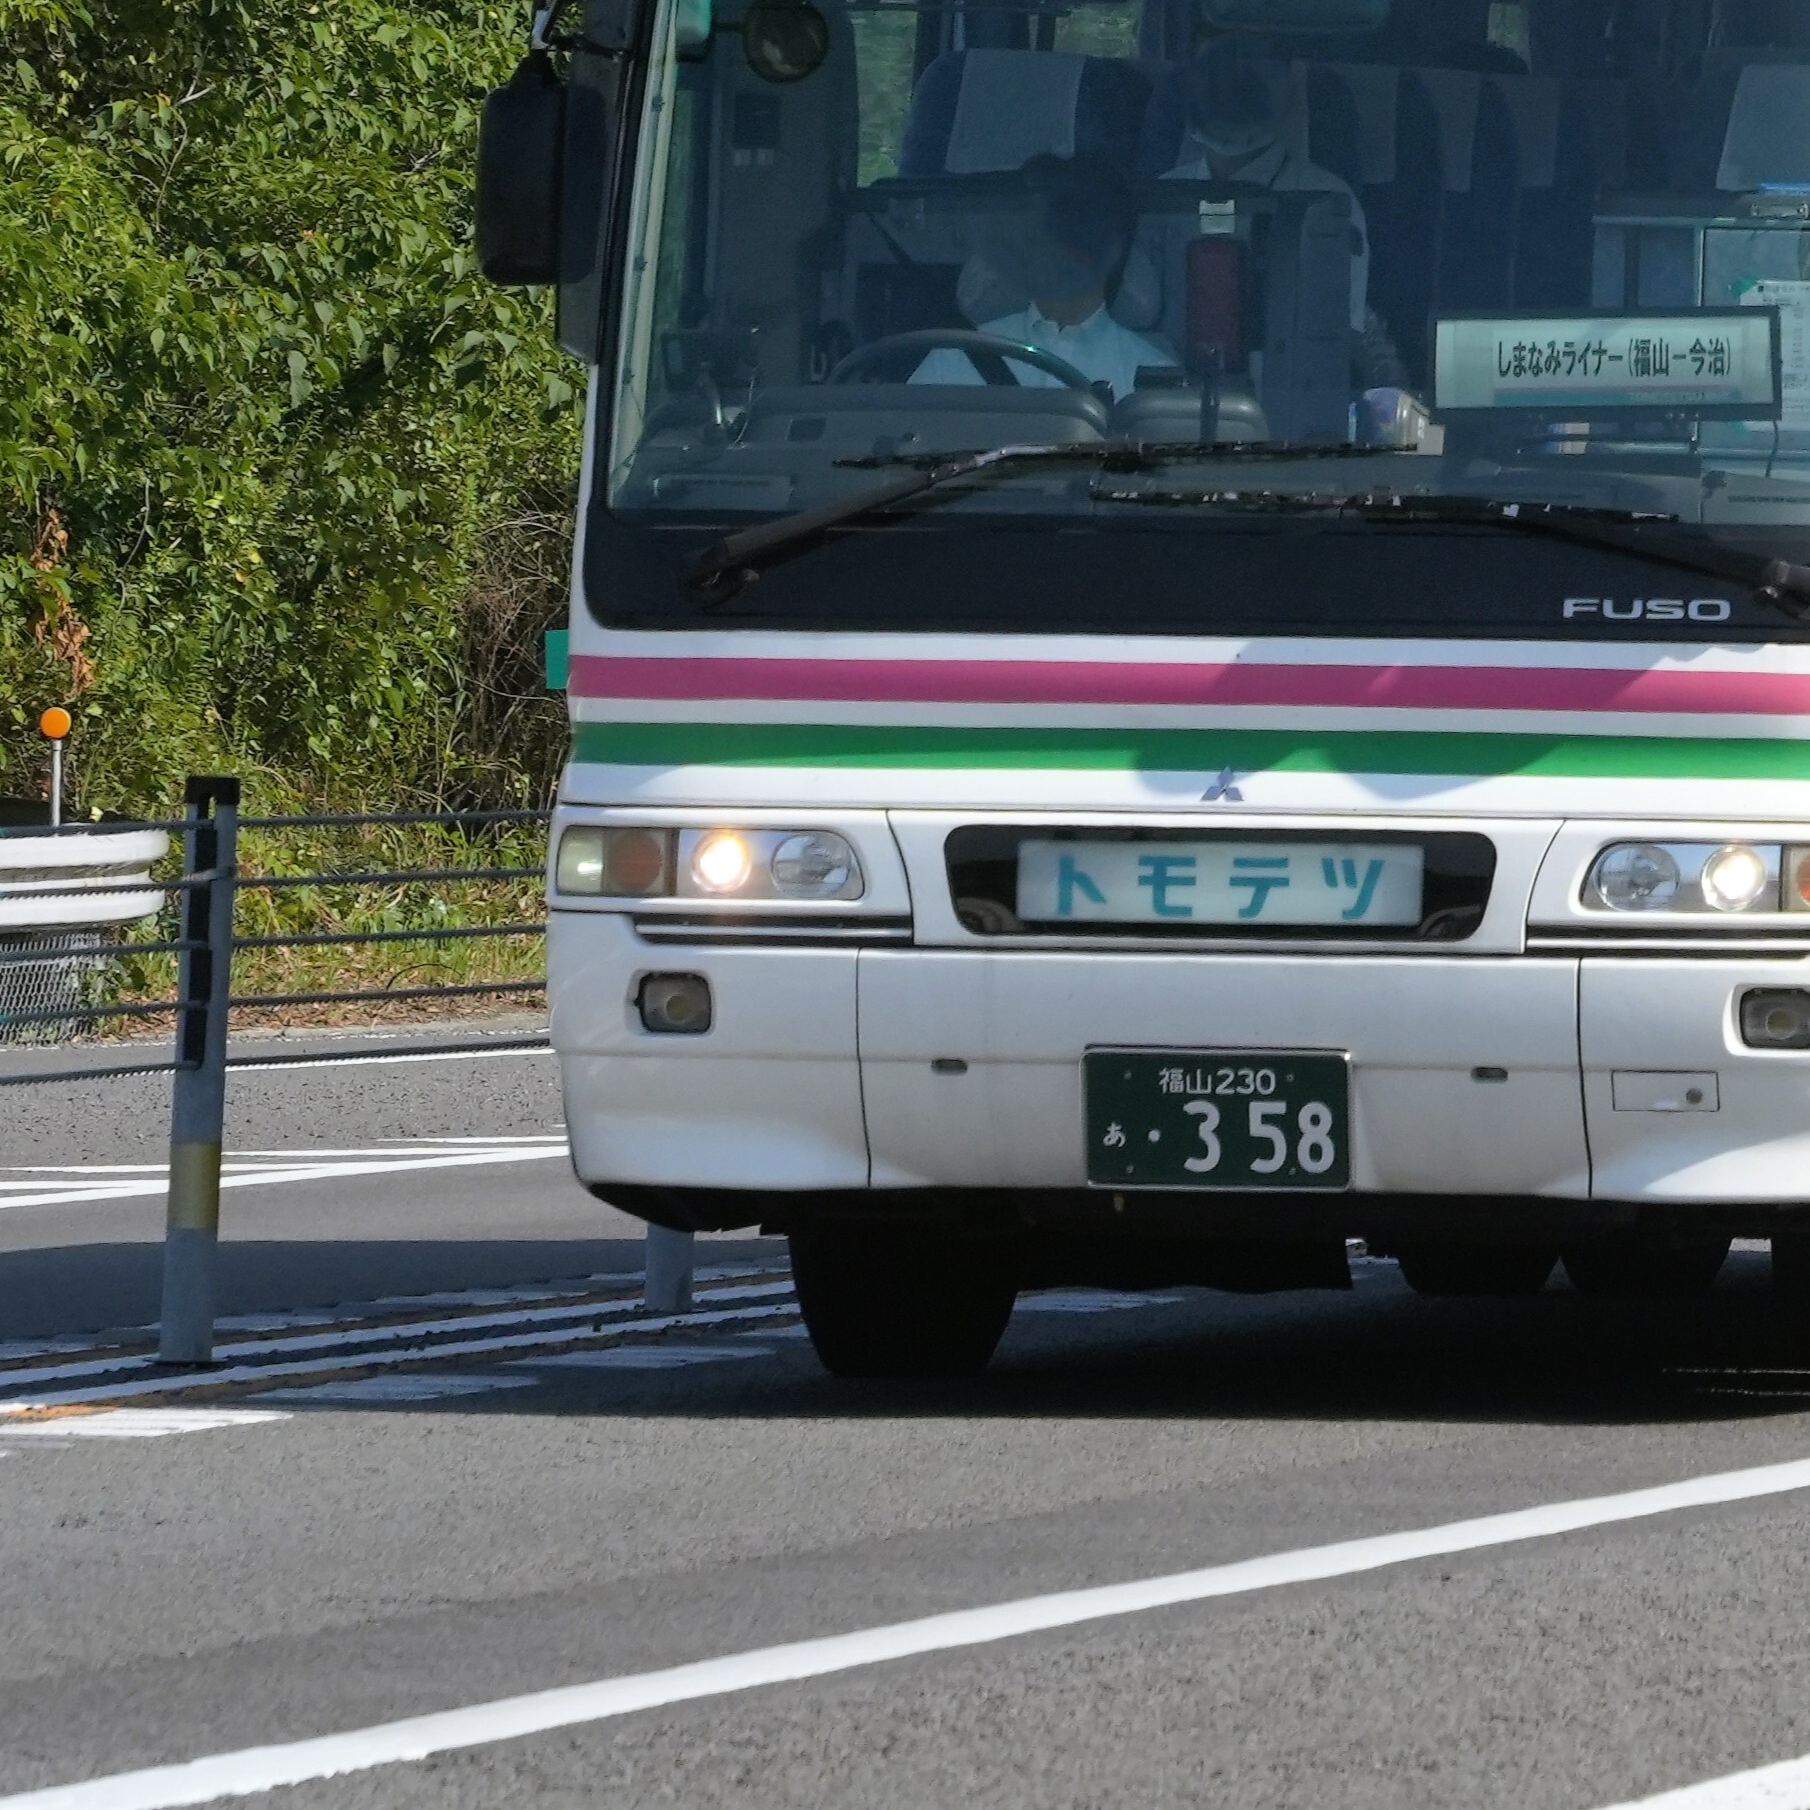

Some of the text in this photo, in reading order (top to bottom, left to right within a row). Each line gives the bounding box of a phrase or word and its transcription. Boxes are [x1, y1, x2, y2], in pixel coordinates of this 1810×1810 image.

[1562, 597, 1731, 622] FUSO
[1056, 853, 1385, 920] トモテツ
[1102, 1121, 1127, 1148] あ
